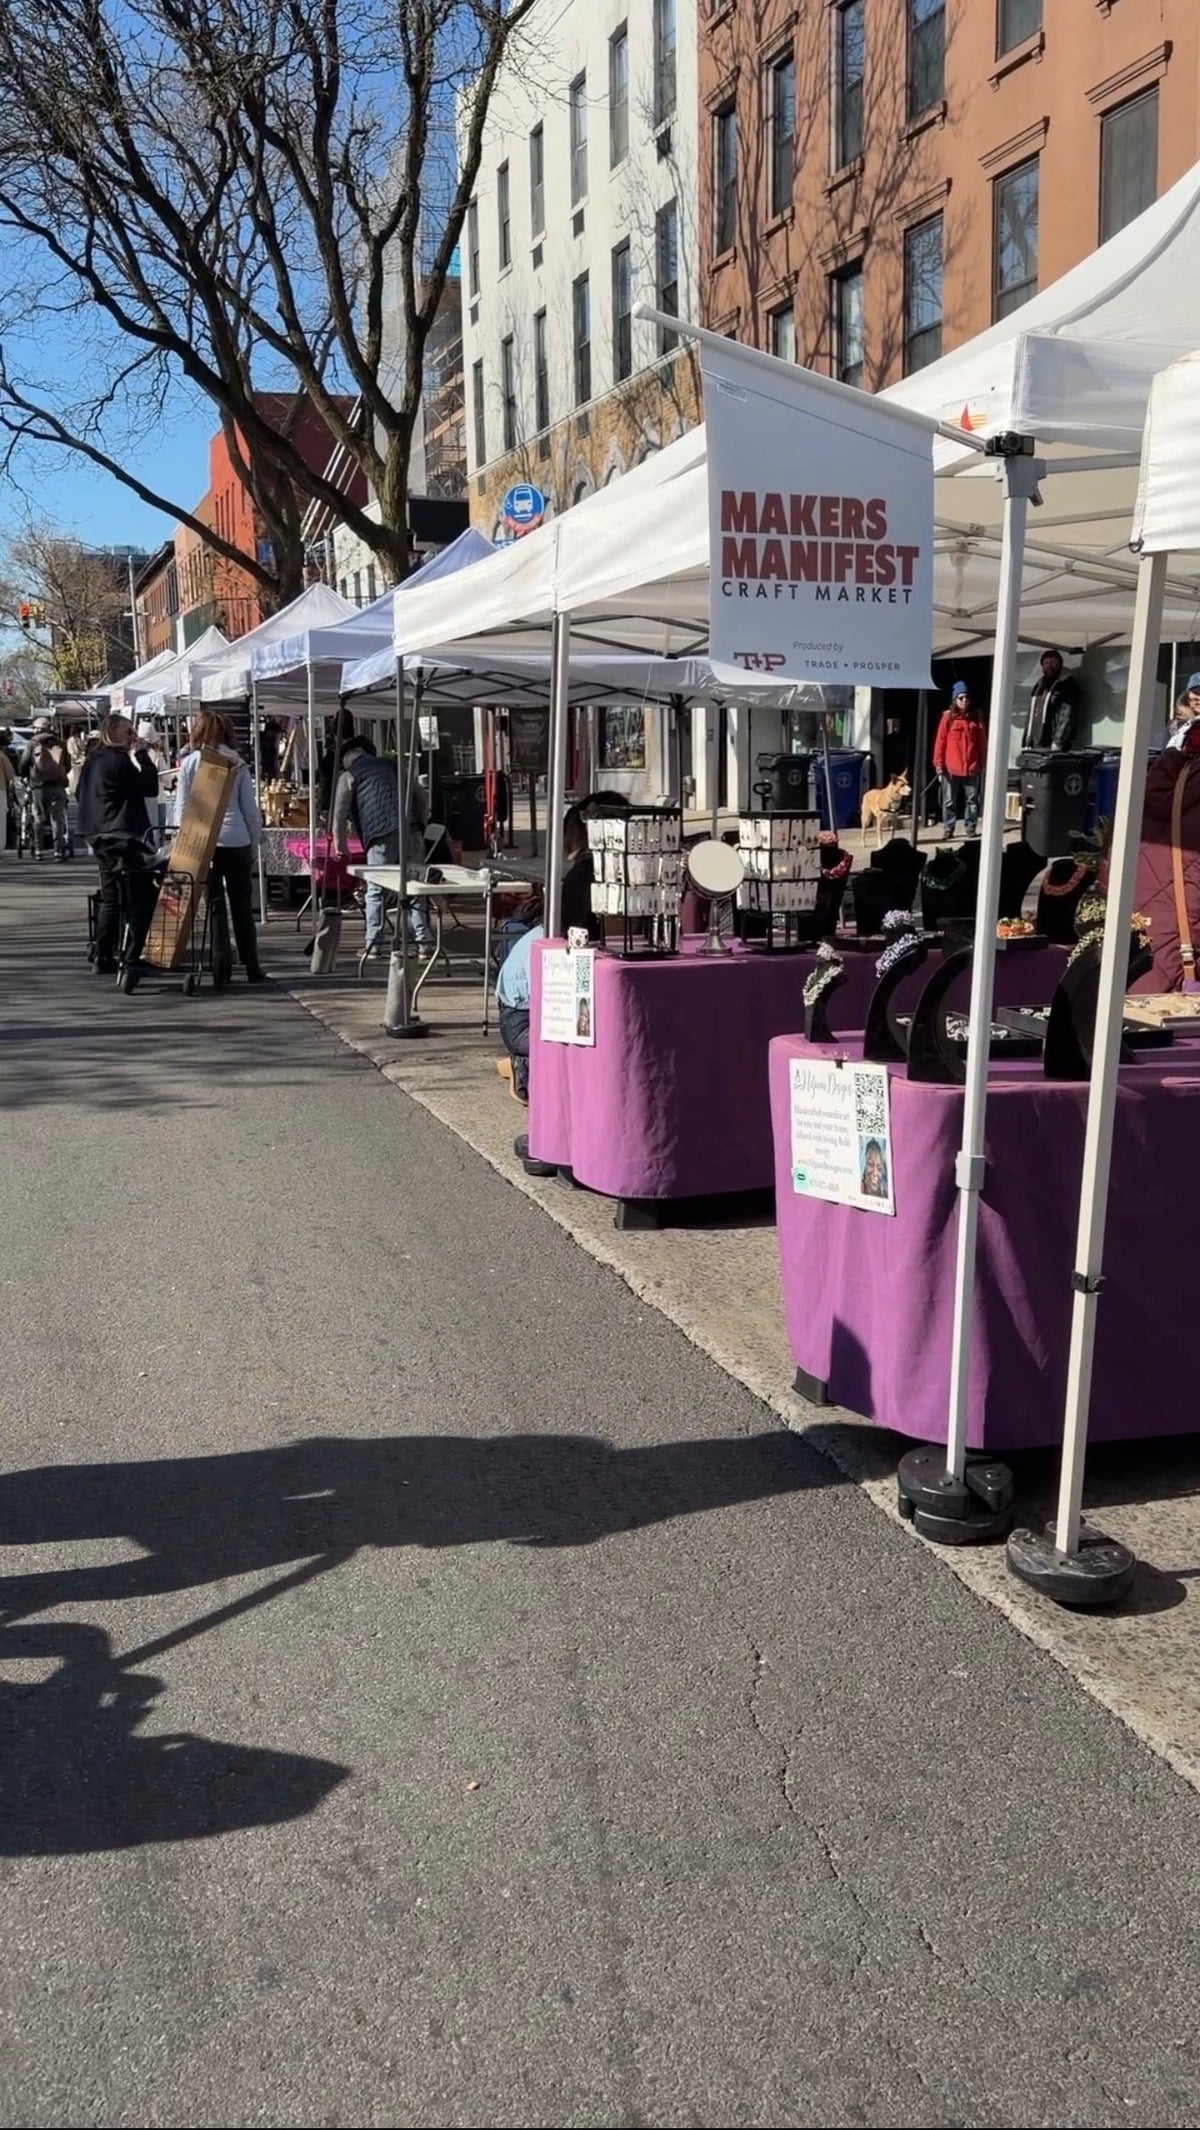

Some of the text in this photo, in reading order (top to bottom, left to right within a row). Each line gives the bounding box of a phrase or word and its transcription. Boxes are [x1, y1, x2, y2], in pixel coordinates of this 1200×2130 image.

[721, 490, 887, 541] MAKERS
[721, 536, 920, 586] MANIFEST
[721, 580, 912, 604] CRAFT MARKET
[793, 640, 844, 653] Produced by
[804, 660, 839, 670] TRADE
[853, 661, 901, 671] PROSPER
